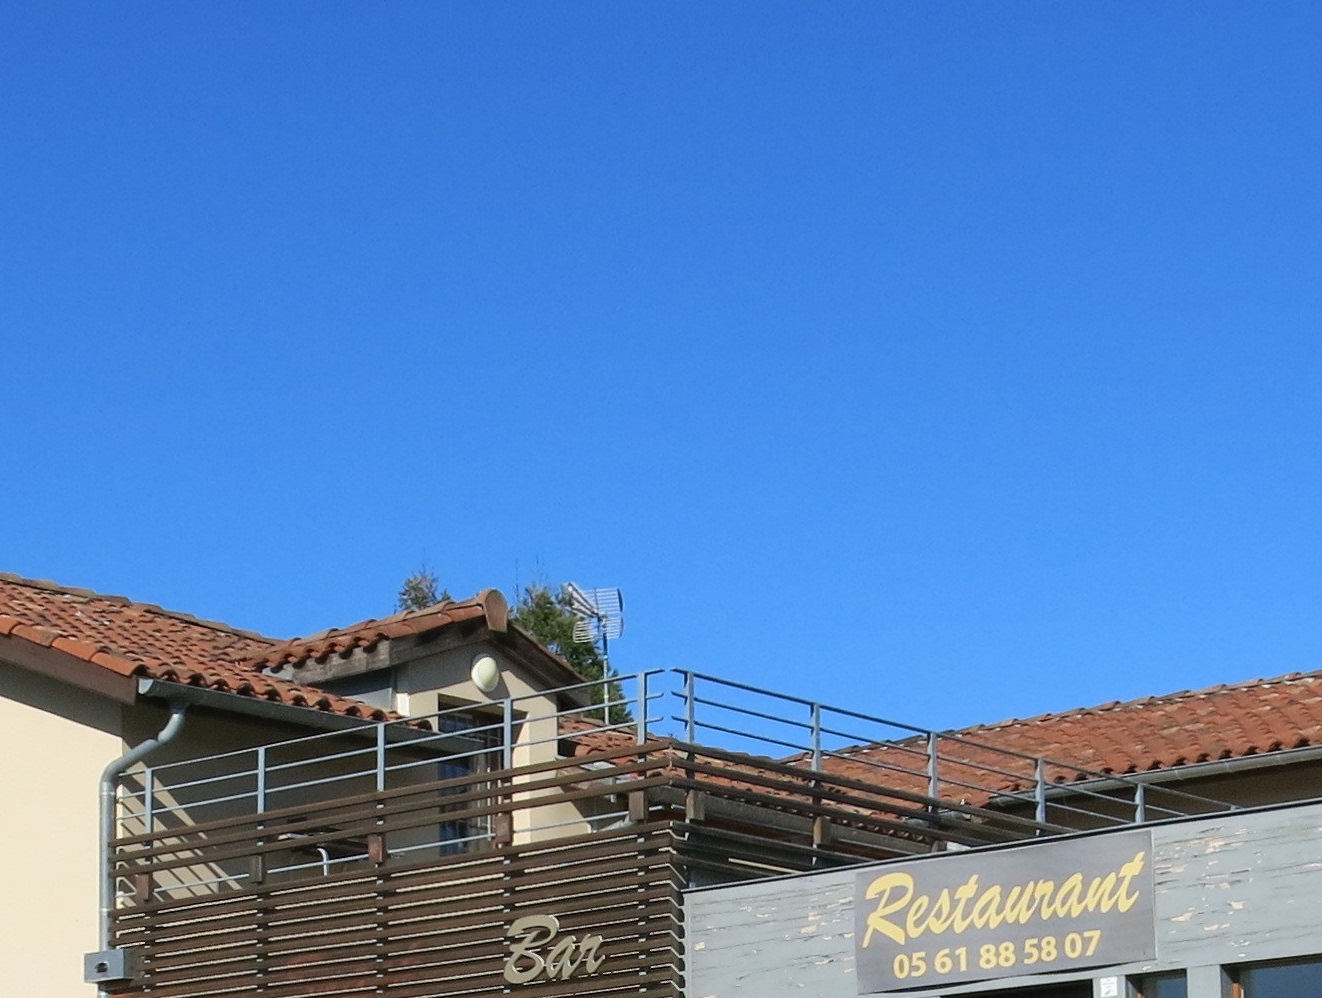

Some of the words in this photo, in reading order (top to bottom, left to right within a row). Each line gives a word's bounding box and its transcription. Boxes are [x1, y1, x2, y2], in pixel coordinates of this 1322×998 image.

[862, 851, 1146, 949] Restaurant
[503, 914, 606, 984] Bar
[892, 951, 927, 980] 05
[933, 946, 969, 975] 61
[978, 941, 1017, 970] 88
[1023, 935, 1058, 965] 58
[1064, 929, 1102, 959] 07
